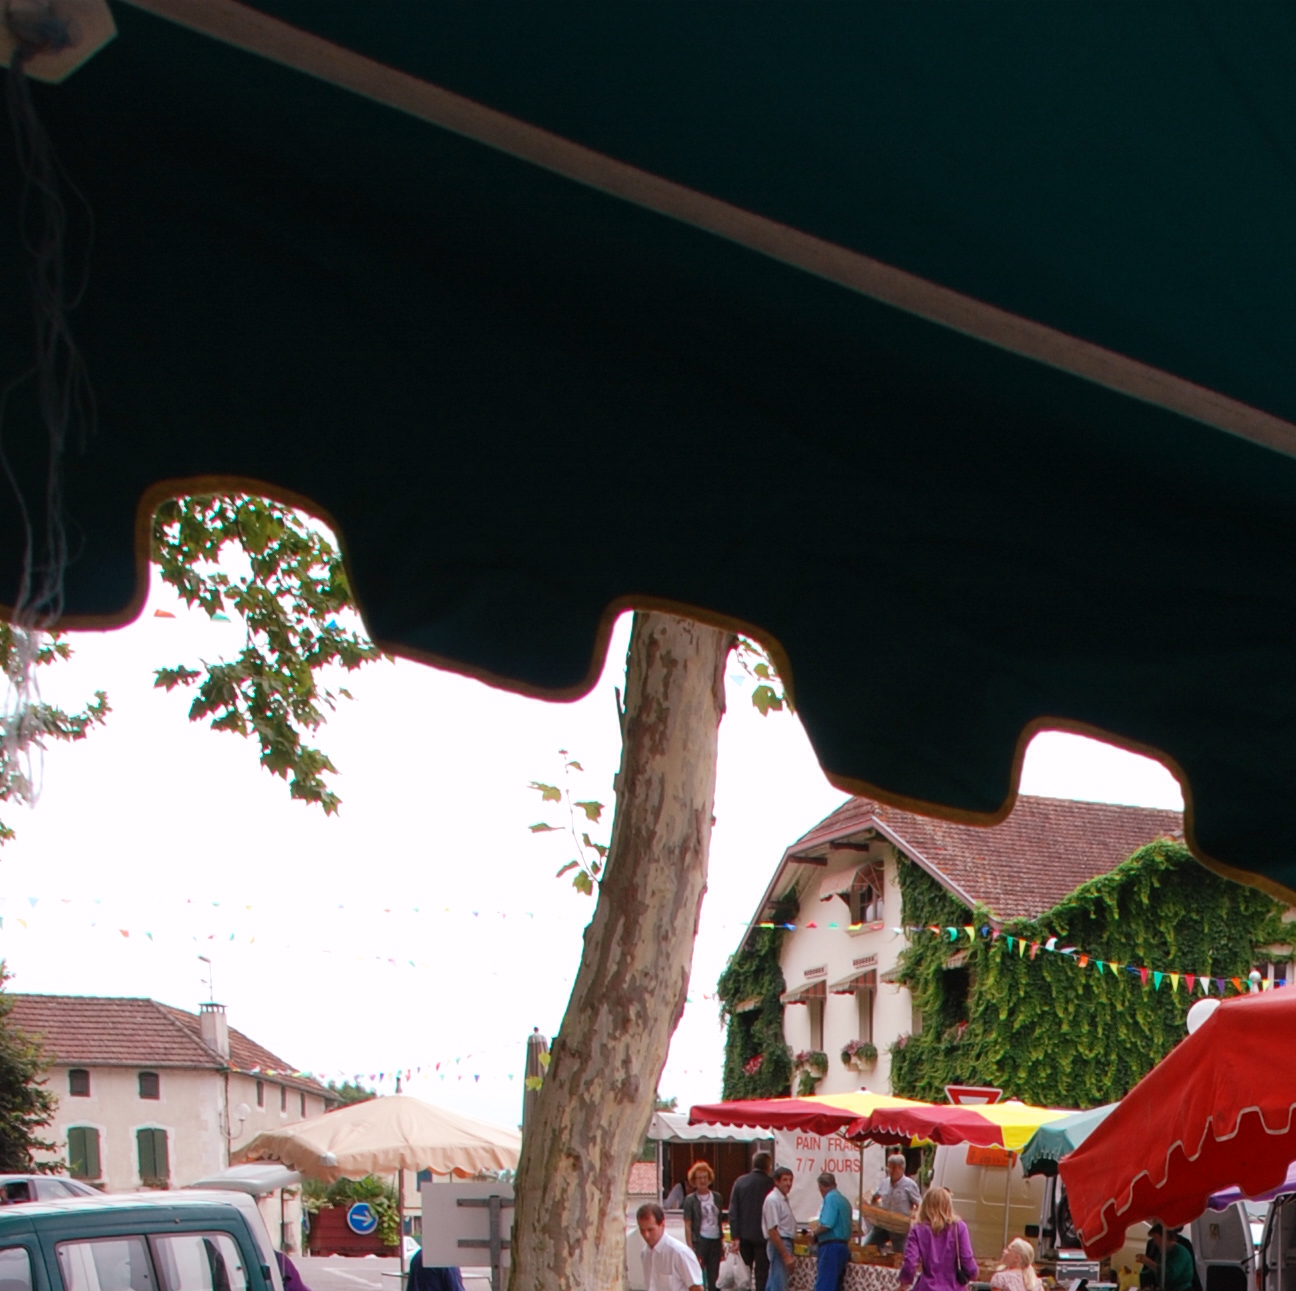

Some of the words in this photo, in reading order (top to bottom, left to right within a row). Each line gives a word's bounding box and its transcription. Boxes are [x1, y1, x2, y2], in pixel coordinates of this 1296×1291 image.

[796, 1137, 820, 1151] PAIN
[796, 1158, 814, 1172] 7/7
[821, 1159, 860, 1173] JOURS
